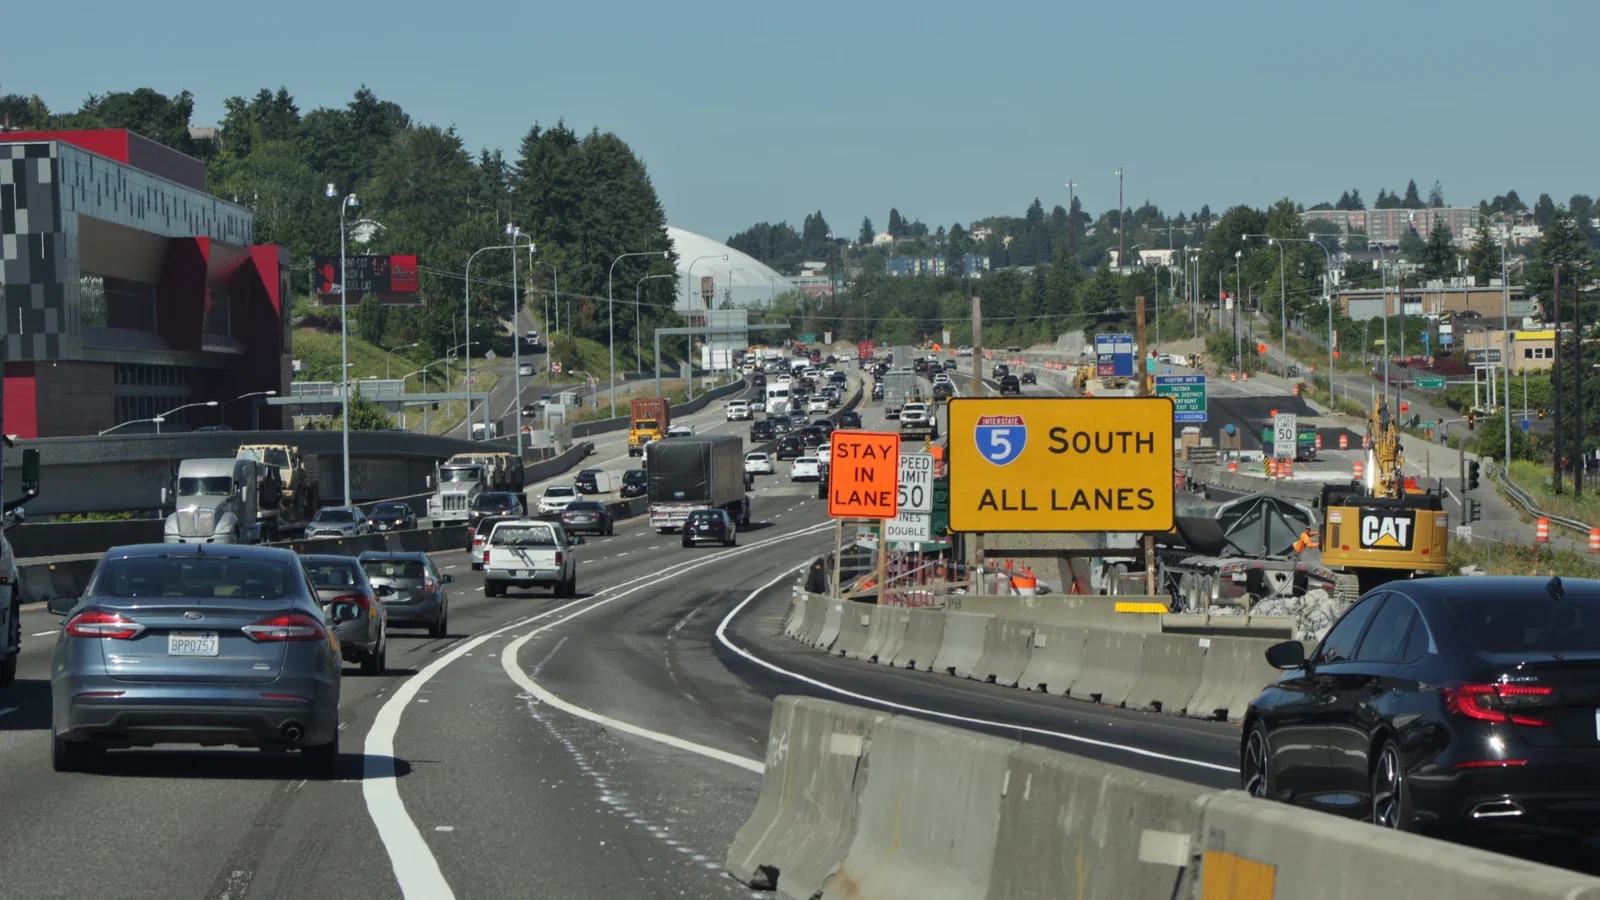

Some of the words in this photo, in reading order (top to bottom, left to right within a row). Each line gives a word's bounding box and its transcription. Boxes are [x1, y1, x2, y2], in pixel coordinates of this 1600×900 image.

[982, 417, 1019, 425] INTERSTATE
[1048, 426, 1154, 454] SOUTH
[1278, 429, 1292, 440] 50
[837, 443, 892, 460] STAY
[990, 429, 1012, 460] 5
[900, 457, 930, 469] PEED
[854, 467, 874, 482] IN
[835, 489, 891, 507] LANE
[898, 485, 924, 507] 50
[977, 488, 1038, 511] ALL
[1051, 487, 1155, 511] LANES
[894, 513, 921, 522] INES
[888, 526, 926, 536] DOUBLE
[1362, 515, 1411, 547] CAT
[171, 639, 216, 652] BPP0757
